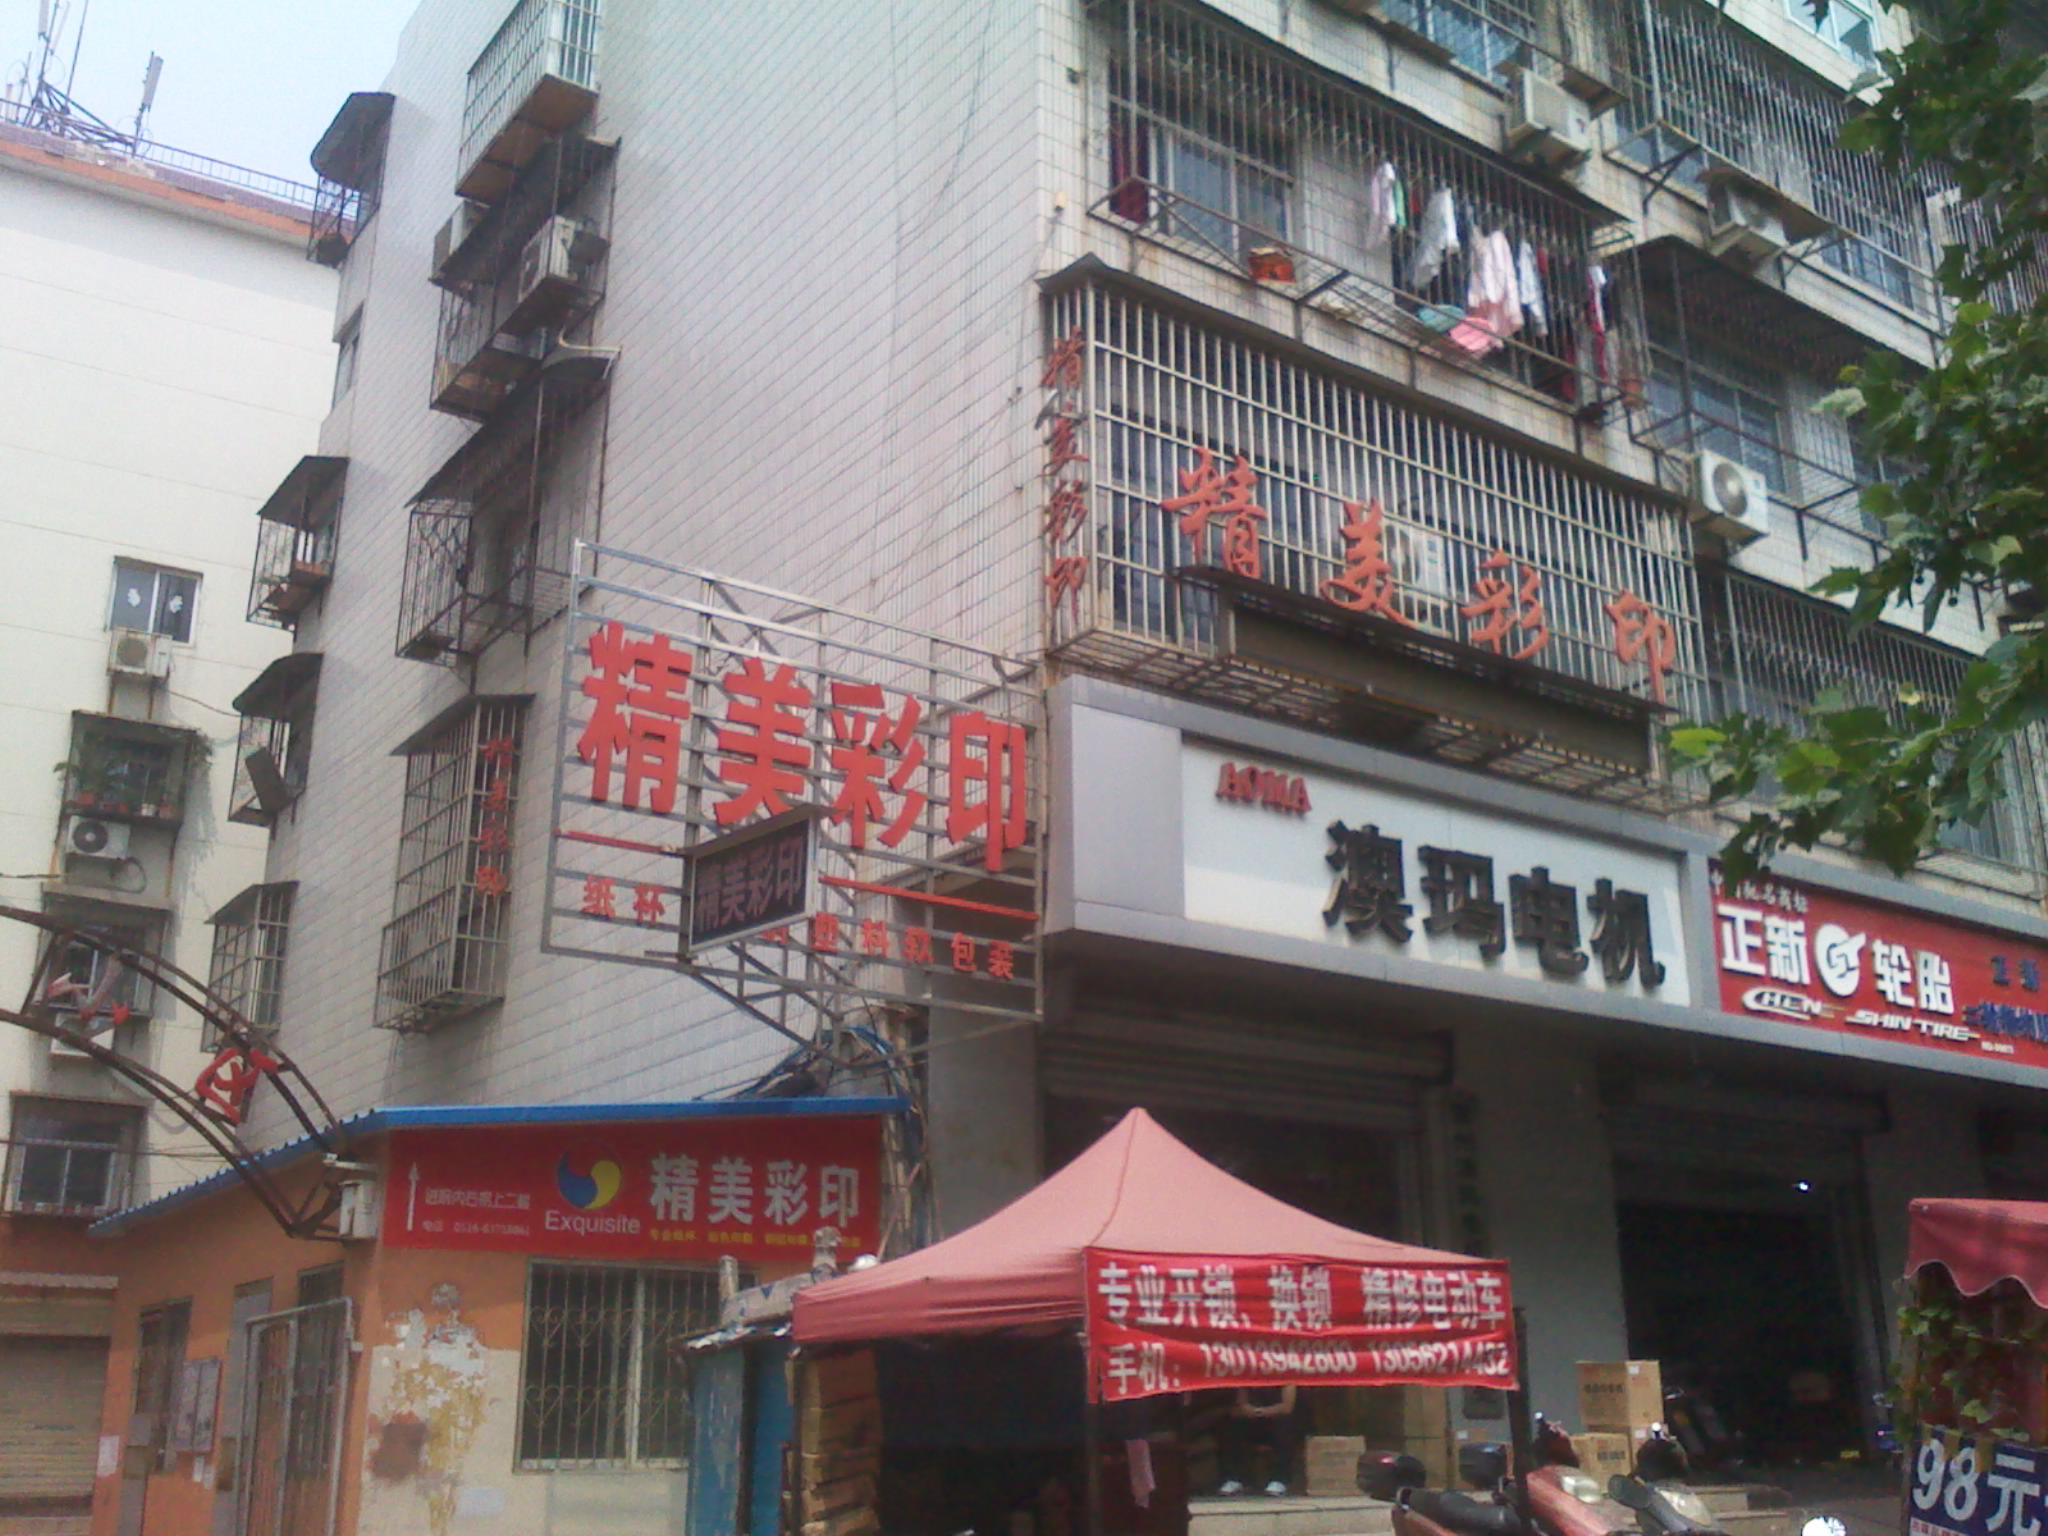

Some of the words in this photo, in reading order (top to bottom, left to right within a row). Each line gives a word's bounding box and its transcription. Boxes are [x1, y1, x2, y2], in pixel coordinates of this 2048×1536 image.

[1162, 447, 1675, 702] 精美彩印
[577, 621, 1027, 872] 精美彩印
[1322, 820, 1665, 990] 澳玛电机
[1717, 904, 1811, 985] 正新
[1872, 939, 1955, 1015] 轮胎
[1845, 1009, 1911, 1031] SHIN
[1912, 1019, 1970, 1041] TIRE
[545, 1210, 641, 1236] Exquisite
[649, 1153, 861, 1229] 精美彩印
[1268, 1264, 1332, 1331] 换锁
[1912, 1438, 2041, 1536] 98元
